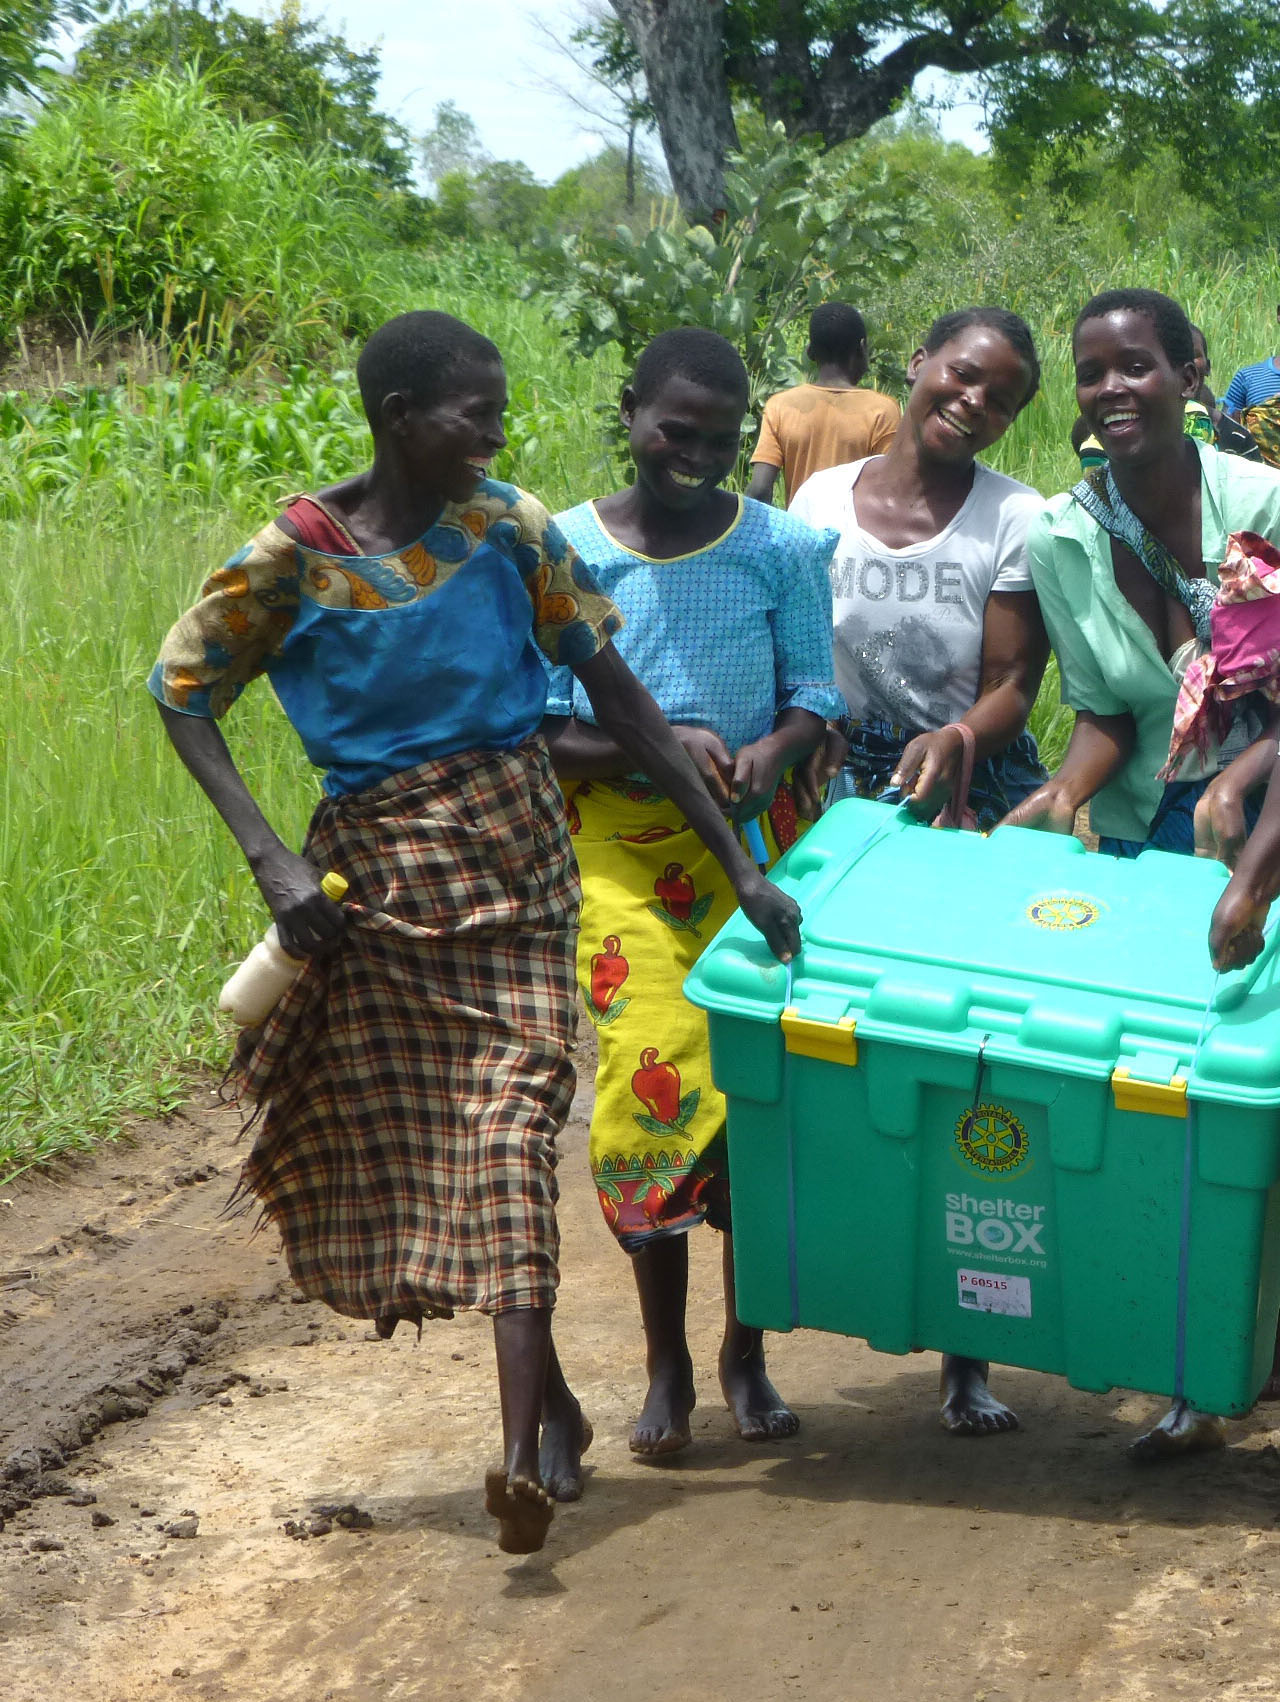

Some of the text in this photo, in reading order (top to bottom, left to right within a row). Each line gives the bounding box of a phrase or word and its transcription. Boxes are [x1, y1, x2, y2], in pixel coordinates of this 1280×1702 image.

[829, 557, 965, 603] MODE
[945, 1193, 1046, 1221] shelter
[945, 1211, 1046, 1255] BOX
[960, 1275, 1008, 1290] P 60515
